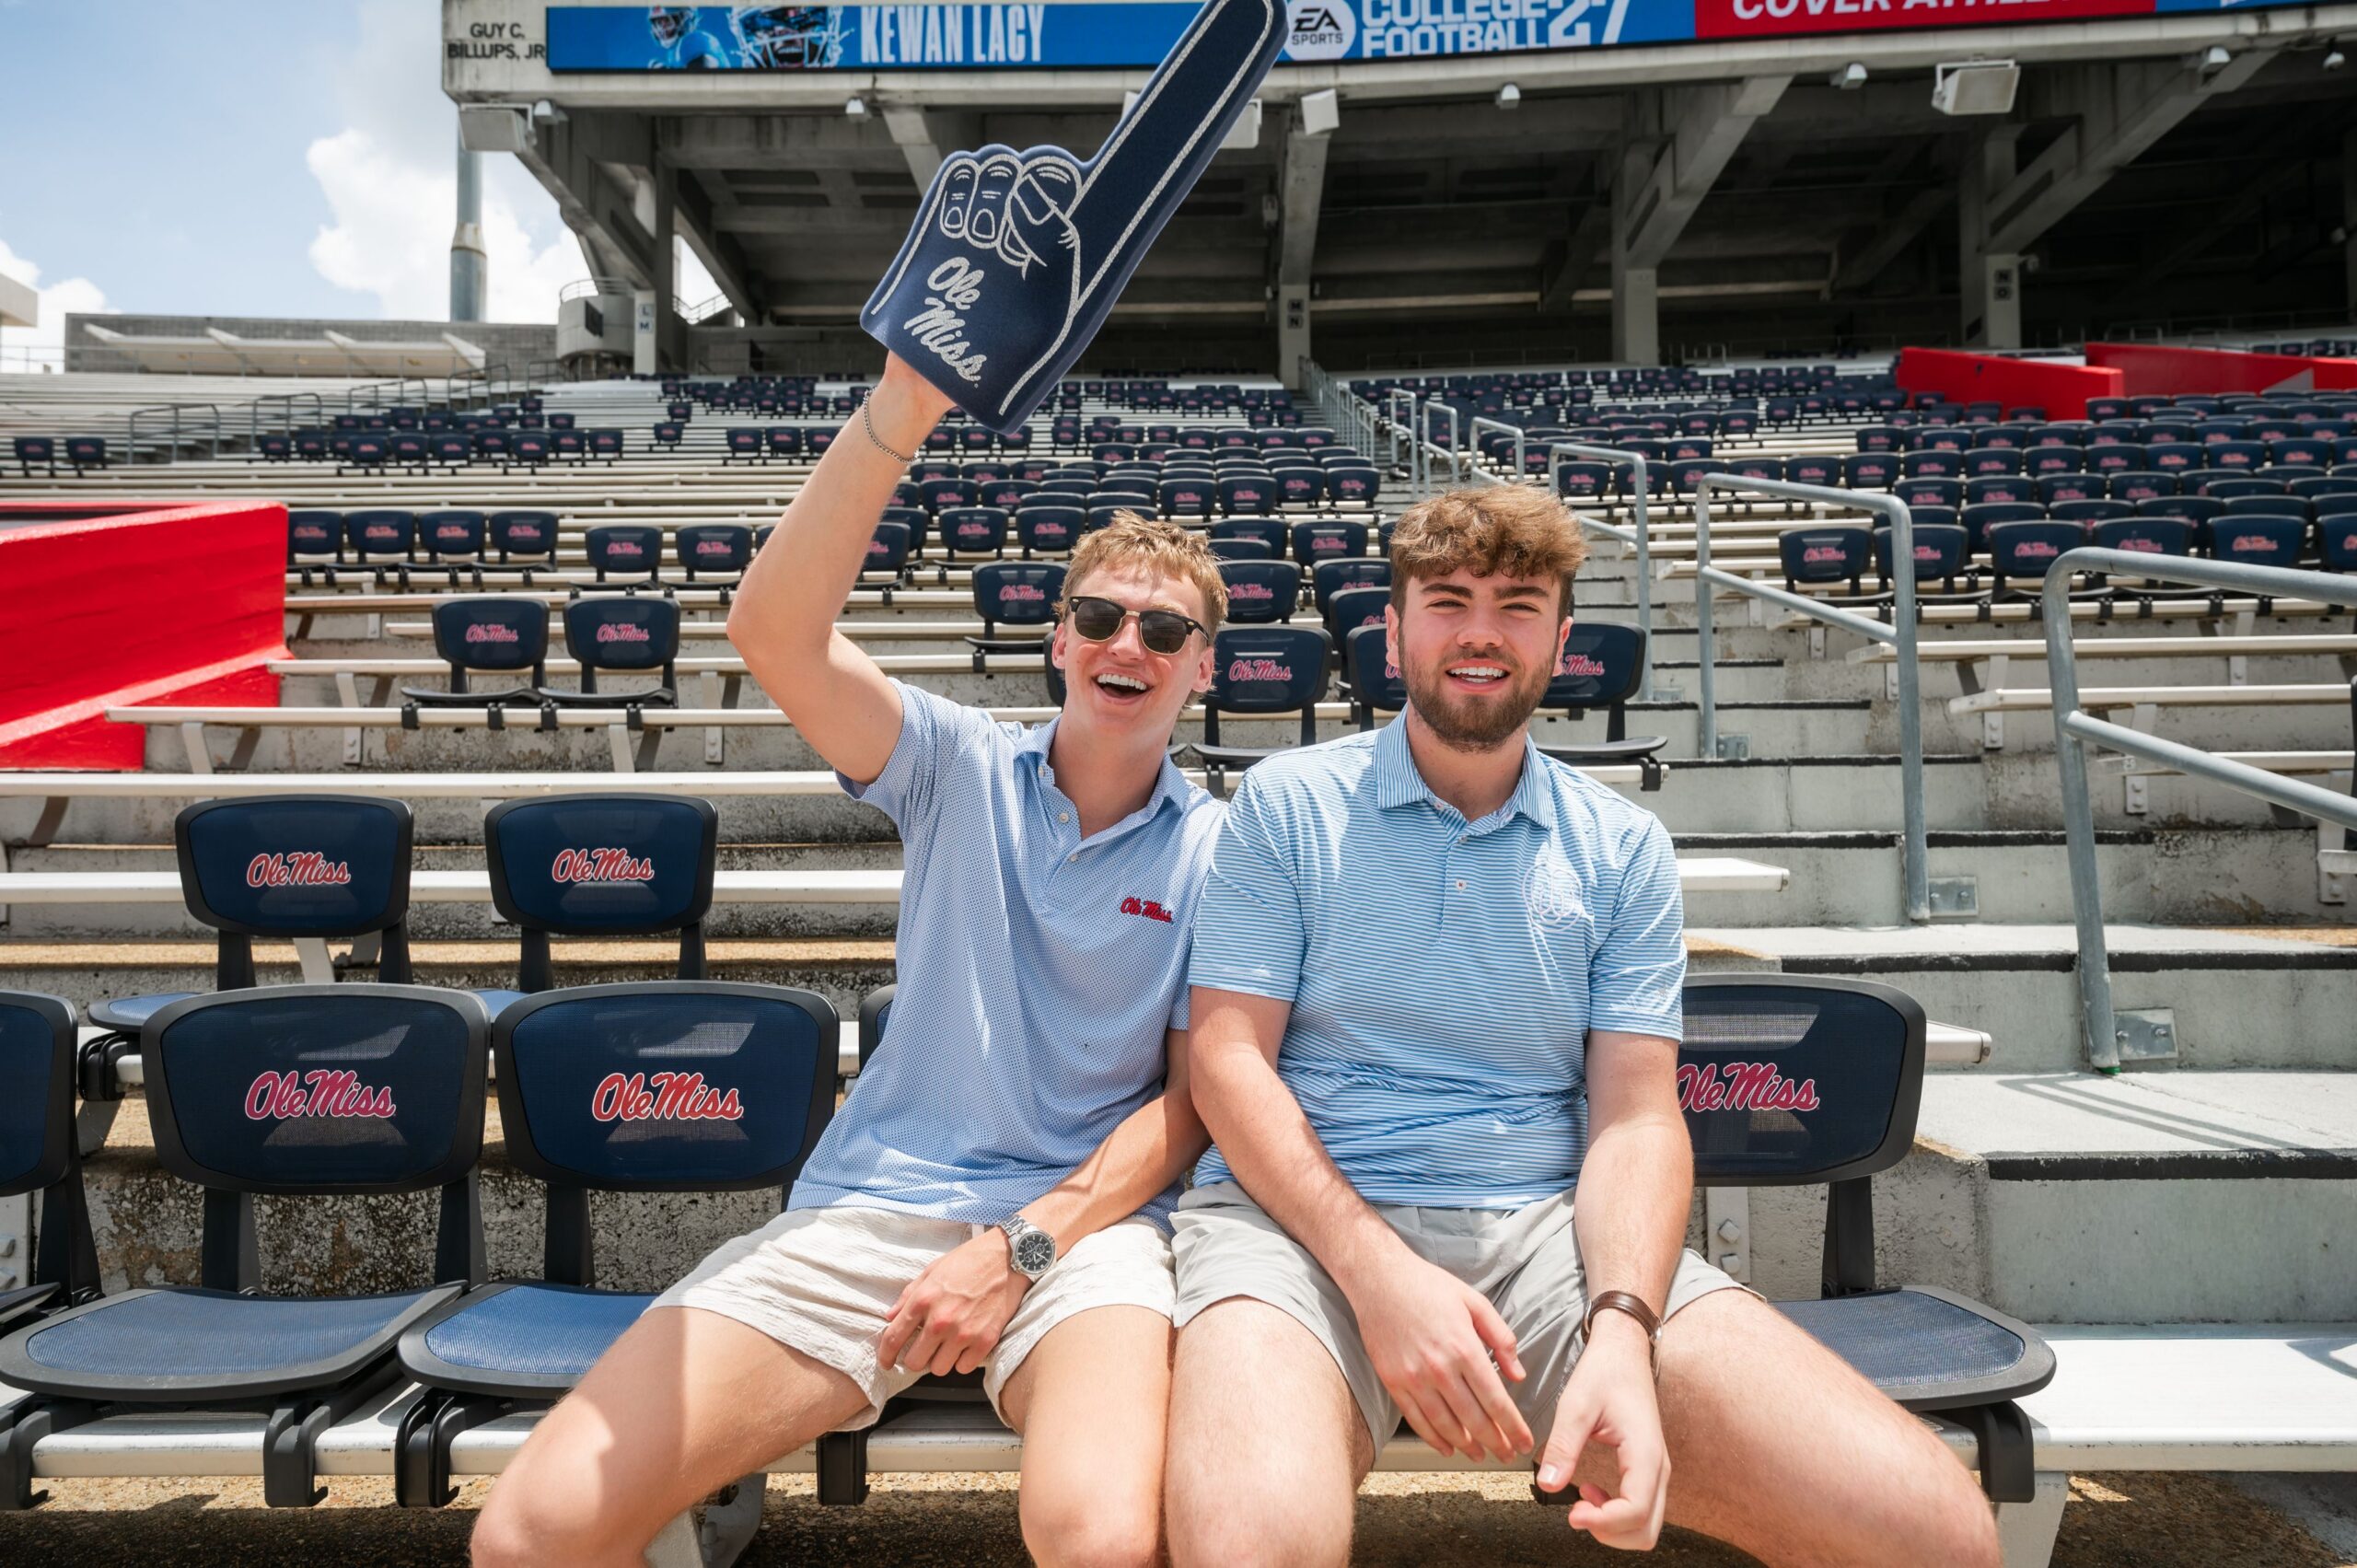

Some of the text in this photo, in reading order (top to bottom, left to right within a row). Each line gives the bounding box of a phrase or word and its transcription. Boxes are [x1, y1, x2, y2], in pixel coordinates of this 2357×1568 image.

[1294, 8, 1342, 32] EA
[1362, 0, 1547, 28] COLLEGE
[470, 23, 506, 39] GUY
[860, 6, 1045, 64] KEWAN LACY
[1291, 32, 1344, 46] SPORTS
[1362, 18, 1549, 59] FOOTBALL
[447, 43, 520, 61] BILLUPS,
[927, 256, 984, 310] Ole
[1229, 659, 1292, 681] Ole Miss
[1565, 655, 1605, 676] Miss
[247, 853, 351, 888] Ole Miss
[552, 848, 655, 883] Ole Miss
[1120, 897, 1173, 923] Ole Miss
[245, 1069, 396, 1121] Ole Miss
[592, 1072, 744, 1121] Ole Miss
[1724, 1063, 1819, 1112] Miss
